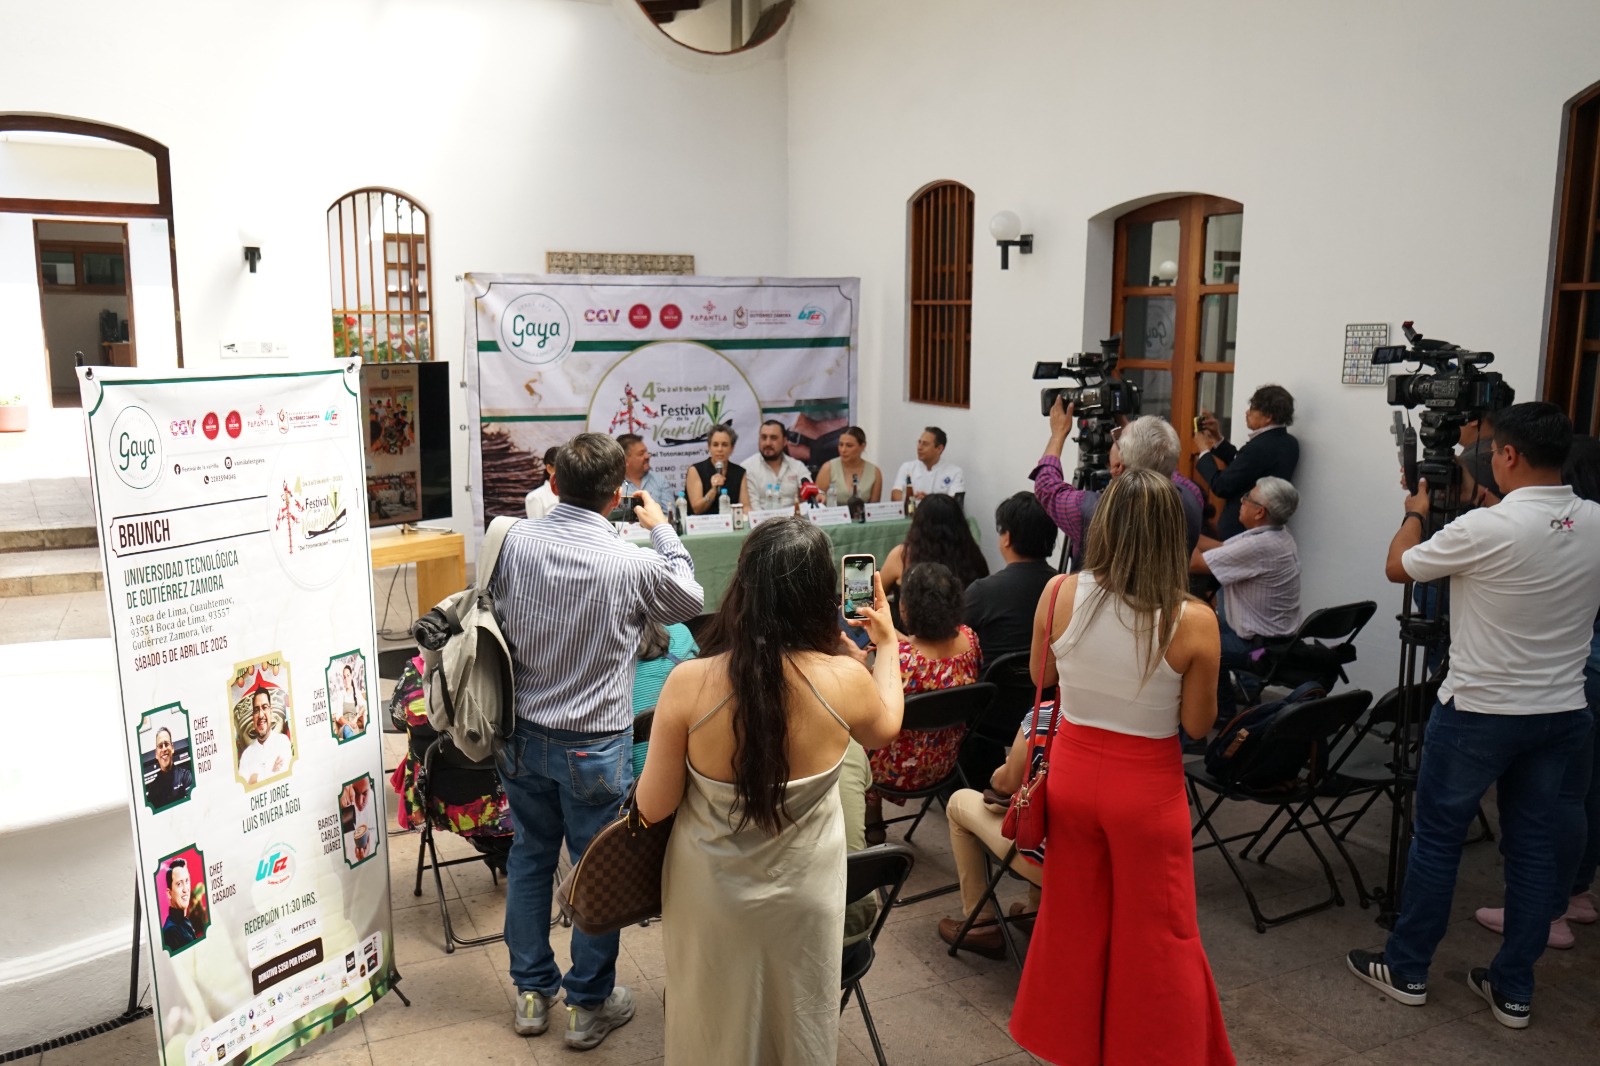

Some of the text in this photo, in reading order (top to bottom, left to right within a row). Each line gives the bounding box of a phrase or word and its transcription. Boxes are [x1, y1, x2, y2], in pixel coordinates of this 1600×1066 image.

[583, 309, 620, 323] CGV
[690, 314, 728, 322] PAPANTLA
[512, 314, 560, 349] Gaya
[642, 381, 656, 402] 4
[660, 403, 705, 417] Festival
[170, 419, 197, 436] CGV
[119, 432, 156, 471] Gaya
[305, 494, 328, 509] Festival
[119, 518, 171, 549] BRUNCH
[124, 550, 239, 587] UNIVERSIDAD TECNOLÓGICA
[126, 574, 224, 609] DE GUTIÉRREZ ZAMORA
[131, 607, 230, 638] 93554 Boca de Lima, 93557
[136, 614, 155, 625] Boca
[156, 610, 166, 621] de
[167, 604, 189, 618] Lima,
[132, 623, 214, 651] Gutiérrez Zamora, Ver.
[134, 635, 228, 672] SÁBADO 5 DE ABRIL DE 2025
[313, 688, 325, 700] CHEF
[312, 700, 327, 713] DIANA
[193, 716, 209, 731] CHEF
[305, 711, 328, 727] ELIZONDO
[194, 729, 215, 745] EDGAR
[196, 743, 218, 759] GARCÍA
[198, 758, 212, 774] RICO
[250, 783, 290, 812] CHEF JORGE
[242, 815, 259, 834] LUIS
[259, 805, 285, 828] RIVERA
[317, 813, 339, 830] BARISTA
[320, 825, 340, 843] CARLOS
[323, 838, 342, 856] JUÁREZ
[209, 861, 223, 877] CHEF
[210, 874, 224, 890] JOSÉ
[212, 884, 236, 905] CASADOS
[244, 891, 318, 936] RECEPCIÓN 11:30 HRS.
[291, 918, 317, 934] IMPETUS
[258, 966, 278, 984] DONATIVO
[289, 956, 298, 968] POR
[298, 948, 317, 963] PERSONA
